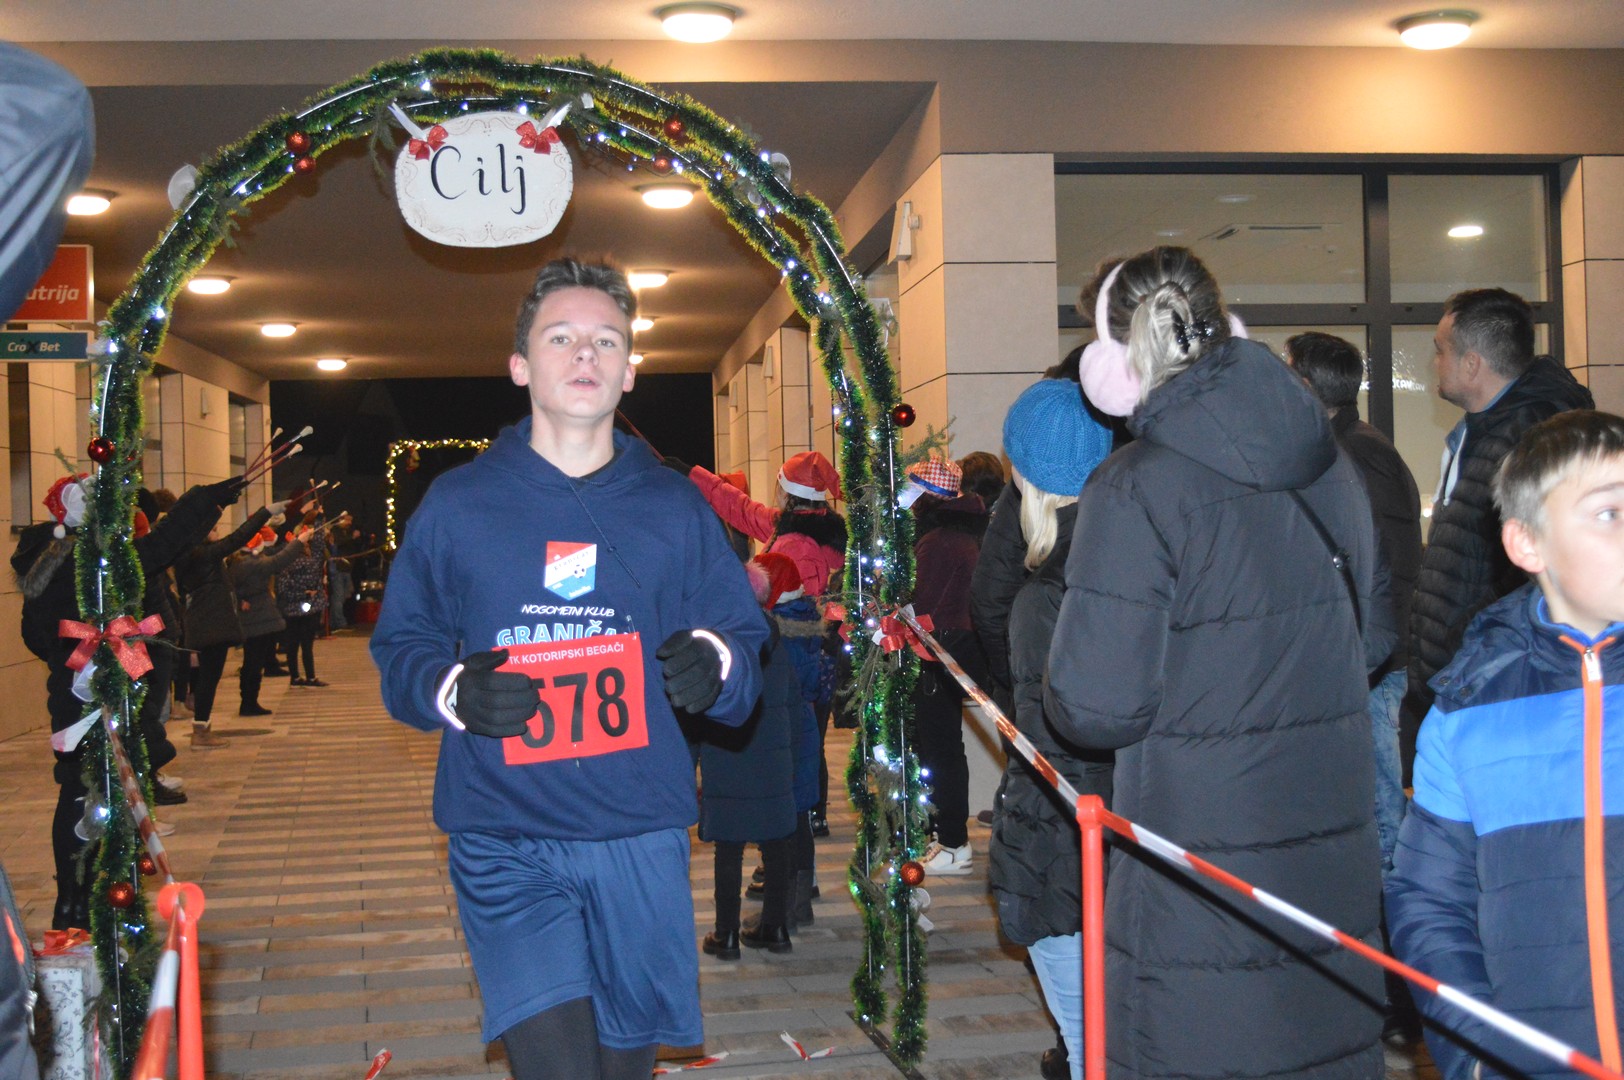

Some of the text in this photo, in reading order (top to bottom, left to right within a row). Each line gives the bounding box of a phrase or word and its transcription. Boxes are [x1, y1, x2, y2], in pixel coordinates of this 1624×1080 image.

[431, 143, 526, 215] Cilj
[26, 285, 79, 304] utrija
[521, 604, 615, 617] NOGOMETNI KLUB
[522, 648, 584, 665] KOTORIPSKI
[586, 641, 624, 656] BEGAČI
